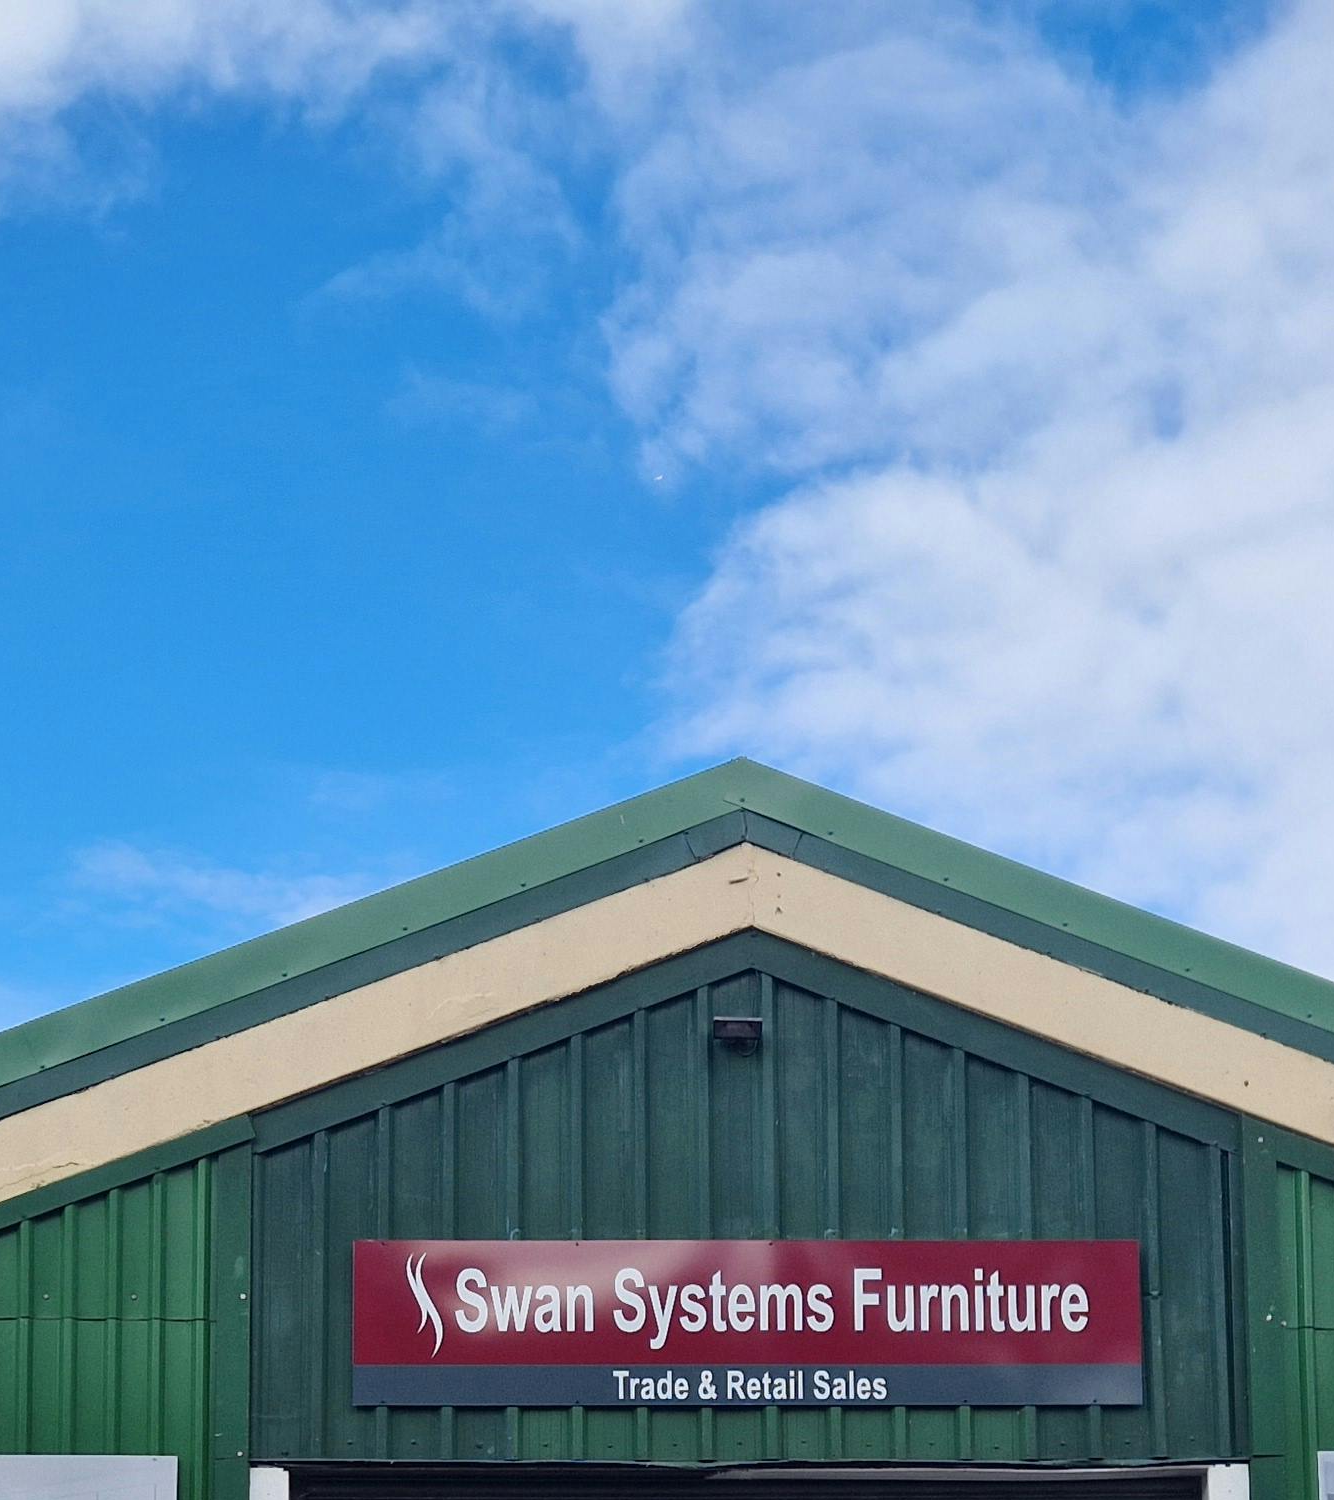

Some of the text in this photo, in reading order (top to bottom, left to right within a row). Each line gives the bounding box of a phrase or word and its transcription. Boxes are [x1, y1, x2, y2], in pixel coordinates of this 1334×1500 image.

[454, 1267, 1090, 1350] Swan Systems Furniture
[612, 1369, 888, 1401] Trade & Retail Sales
